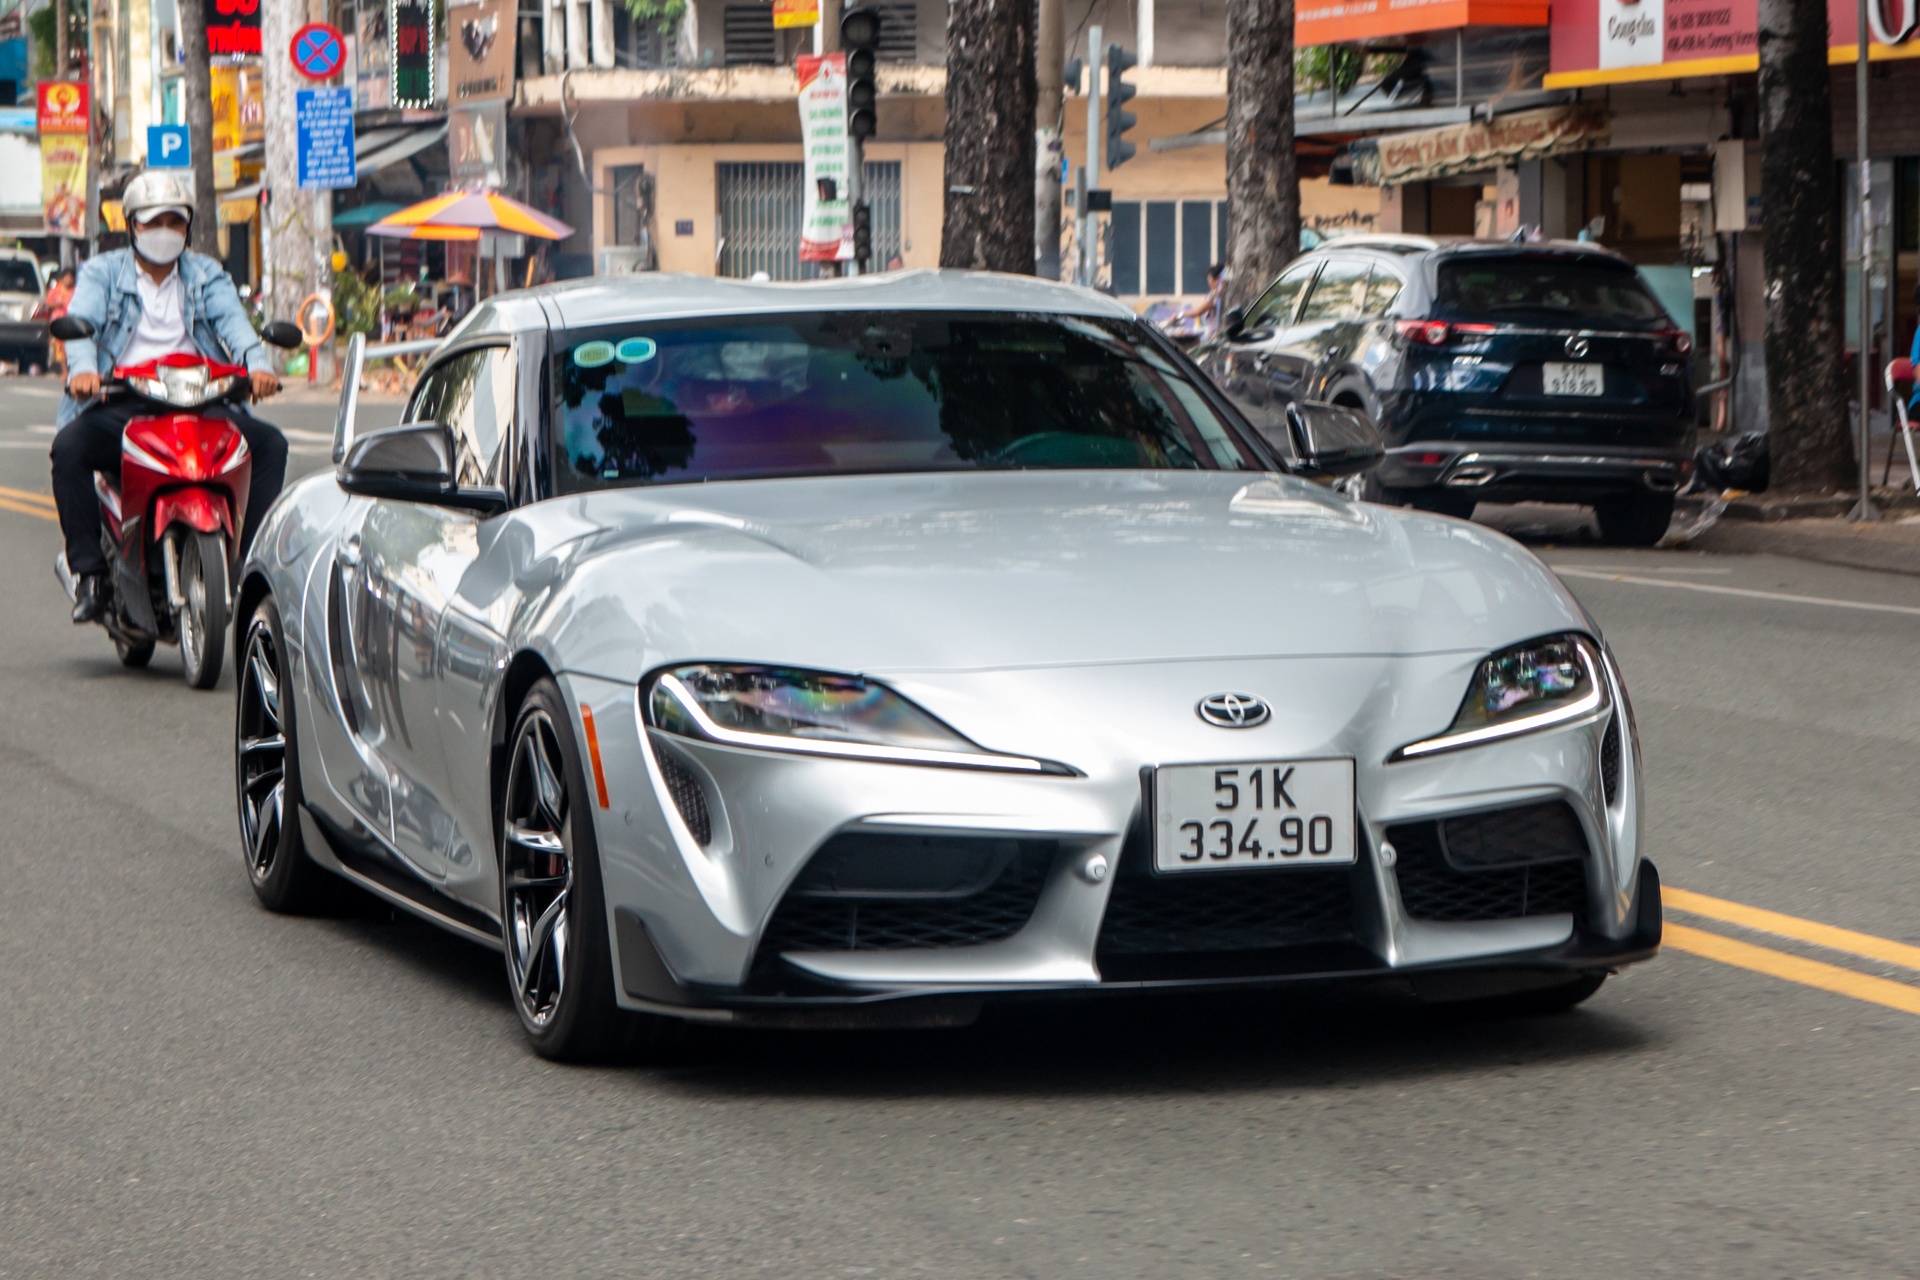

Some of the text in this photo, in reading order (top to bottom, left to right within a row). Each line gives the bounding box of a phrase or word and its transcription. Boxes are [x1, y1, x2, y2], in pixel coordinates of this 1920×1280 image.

[161, 132, 182, 159] P
[1214, 766, 1297, 810] 51K
[1178, 813, 1333, 861] 334.90
